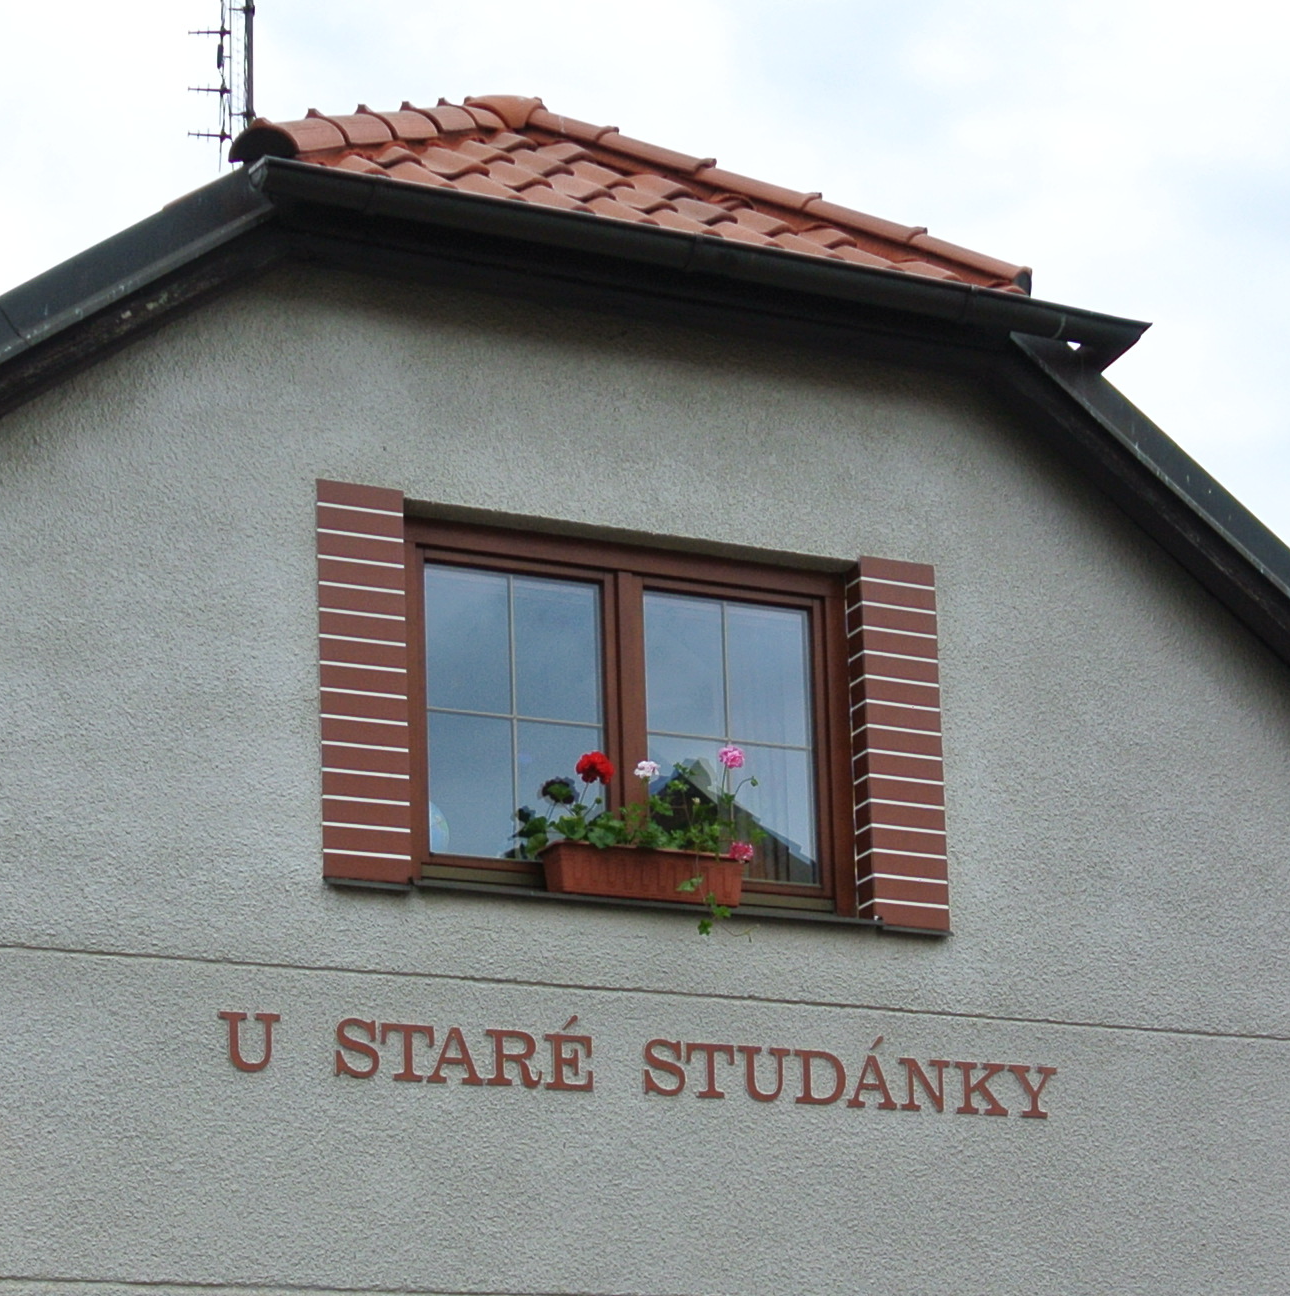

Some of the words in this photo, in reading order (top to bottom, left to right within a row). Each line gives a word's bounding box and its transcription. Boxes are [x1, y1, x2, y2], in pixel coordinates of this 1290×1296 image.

[218, 1010, 282, 1073] U
[333, 1014, 596, 1093] STARÉ
[641, 1035, 1059, 1119] STUDÁNKY
